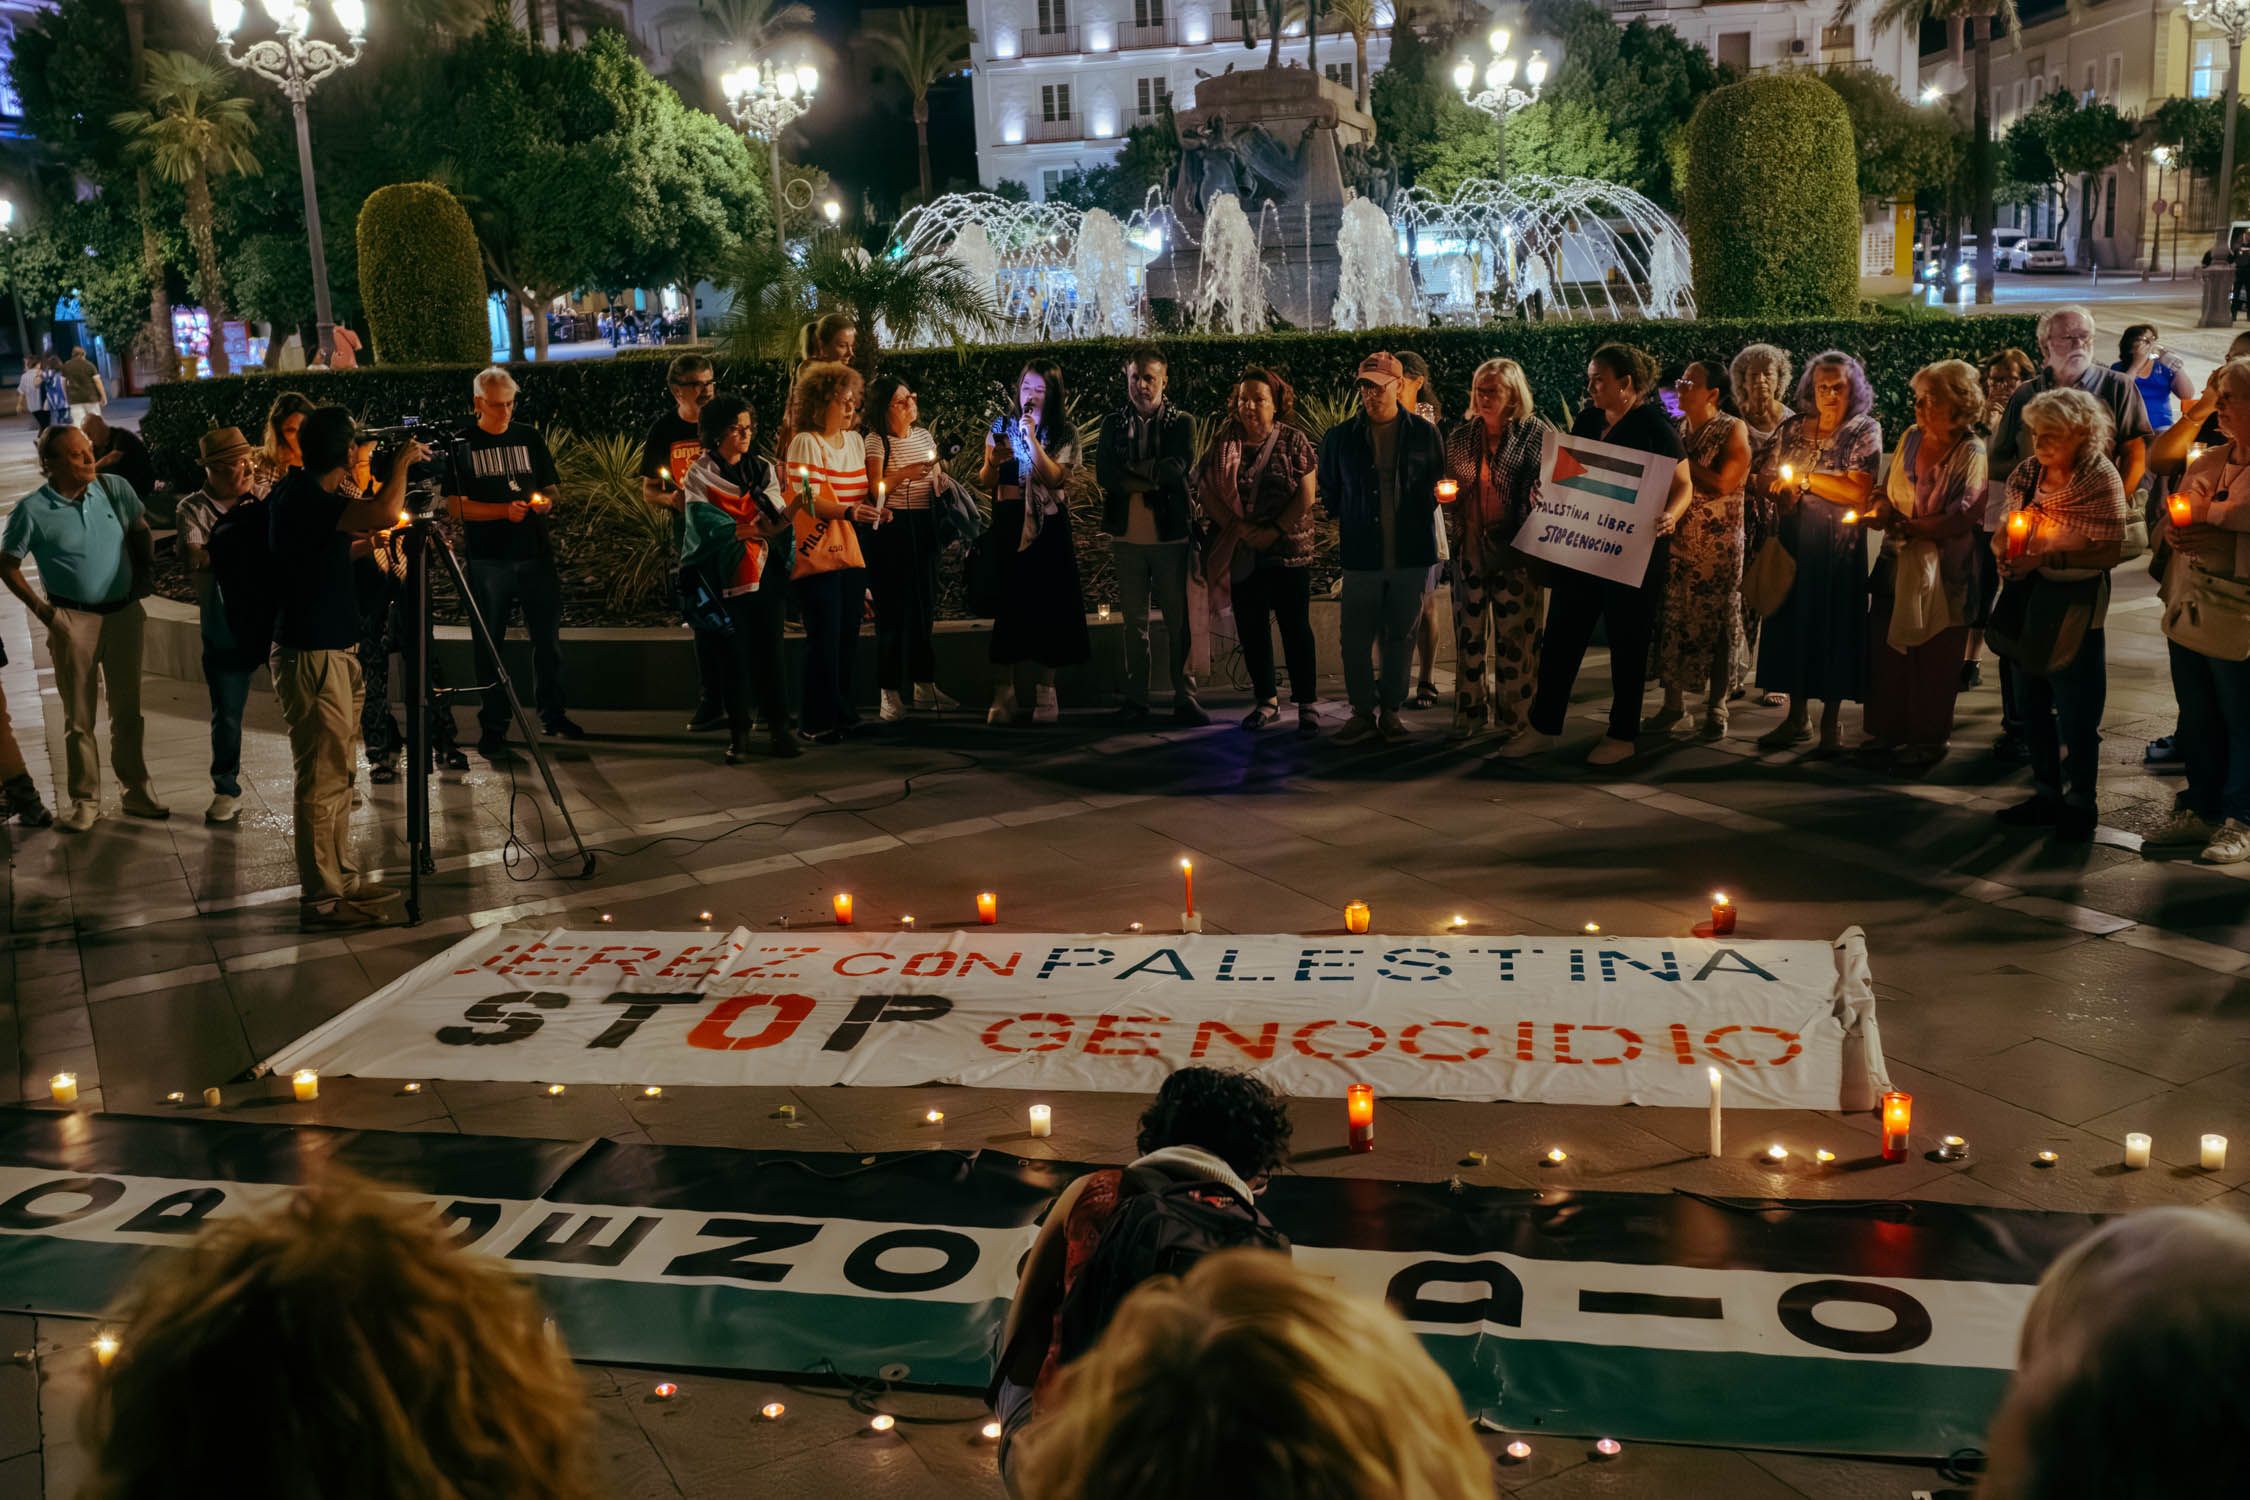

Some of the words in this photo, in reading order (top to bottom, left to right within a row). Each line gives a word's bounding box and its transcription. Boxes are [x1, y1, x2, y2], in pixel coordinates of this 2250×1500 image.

[799, 520, 829, 557] MILA
[453, 943, 821, 978] JEREZ
[833, 951, 1023, 977] CON
[1036, 947, 1779, 982] PALESTINA
[435, 992, 954, 1052] STOP
[981, 1012, 1803, 1065] GENOCIDIO
